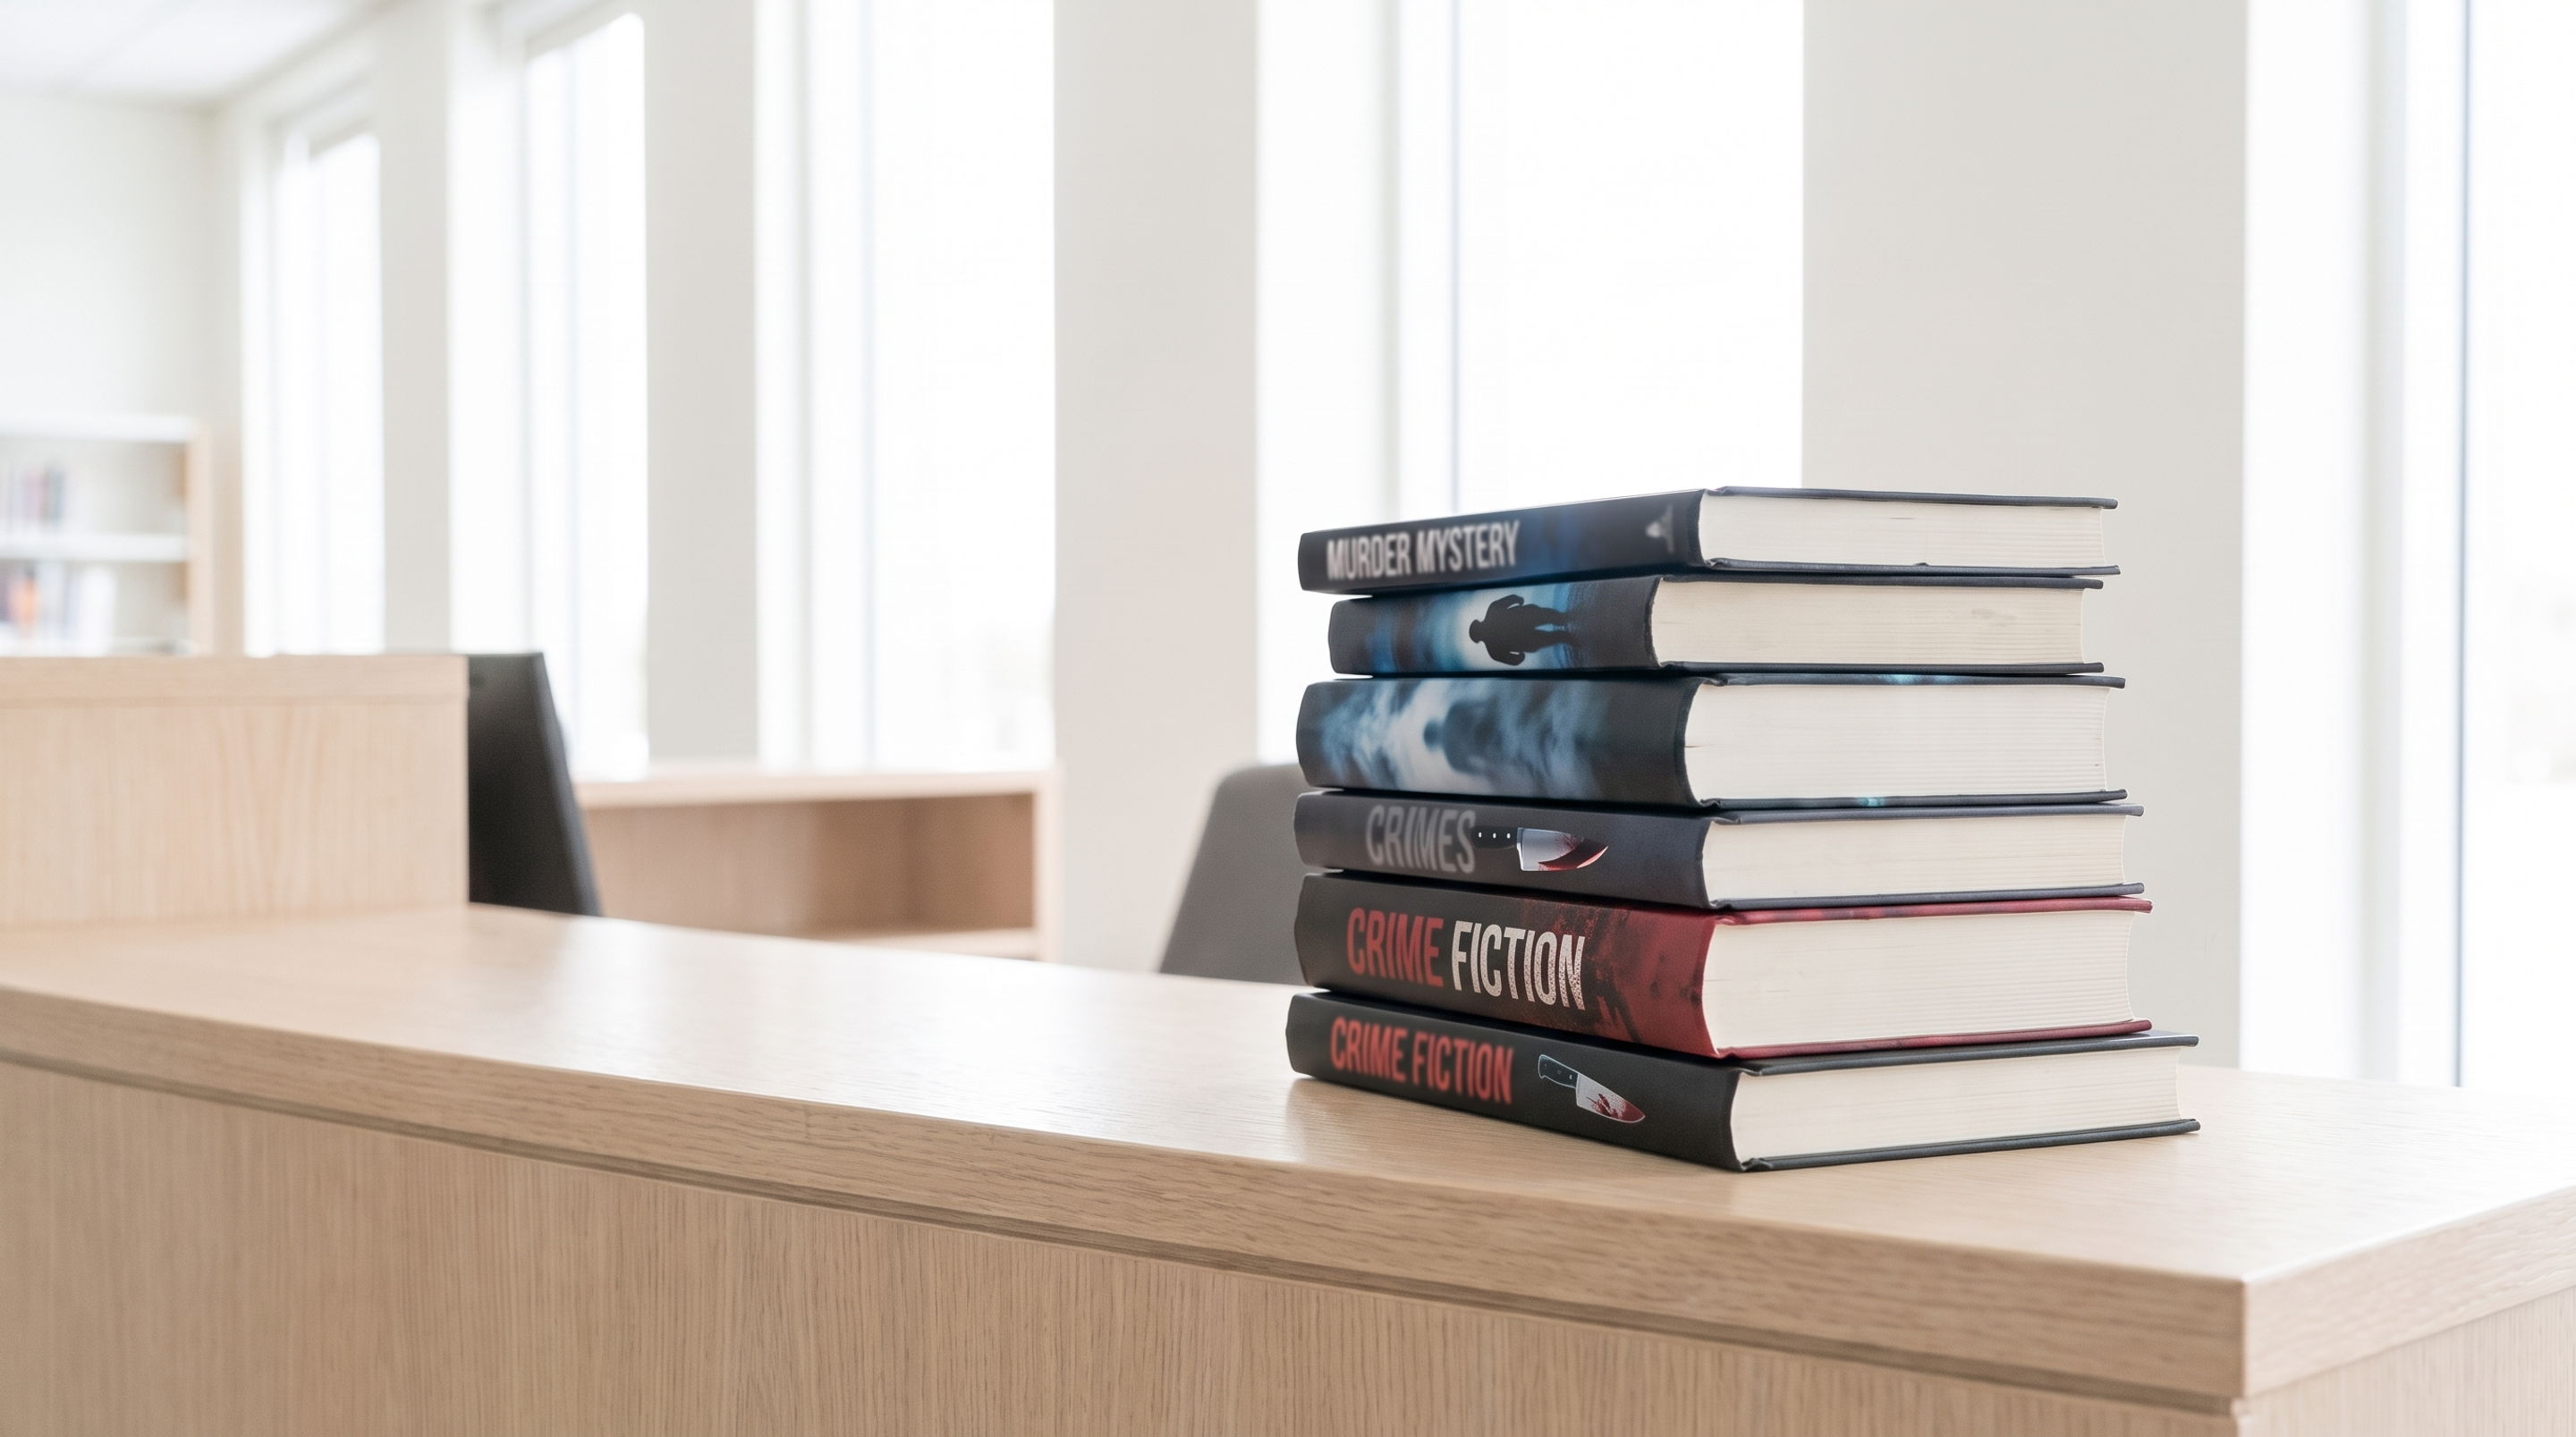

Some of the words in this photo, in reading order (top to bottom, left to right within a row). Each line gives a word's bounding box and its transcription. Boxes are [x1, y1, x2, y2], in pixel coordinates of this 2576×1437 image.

[1327, 532, 1411, 580] MURDER
[1417, 520, 1521, 574] MYSTERY
[1366, 806, 1475, 874] CRIMES
[1347, 908, 1444, 987] CRIME
[1452, 920, 1585, 1010] FICTION
[1330, 1017, 1409, 1083] CRIME
[1412, 1032, 1513, 1104] FICTION
